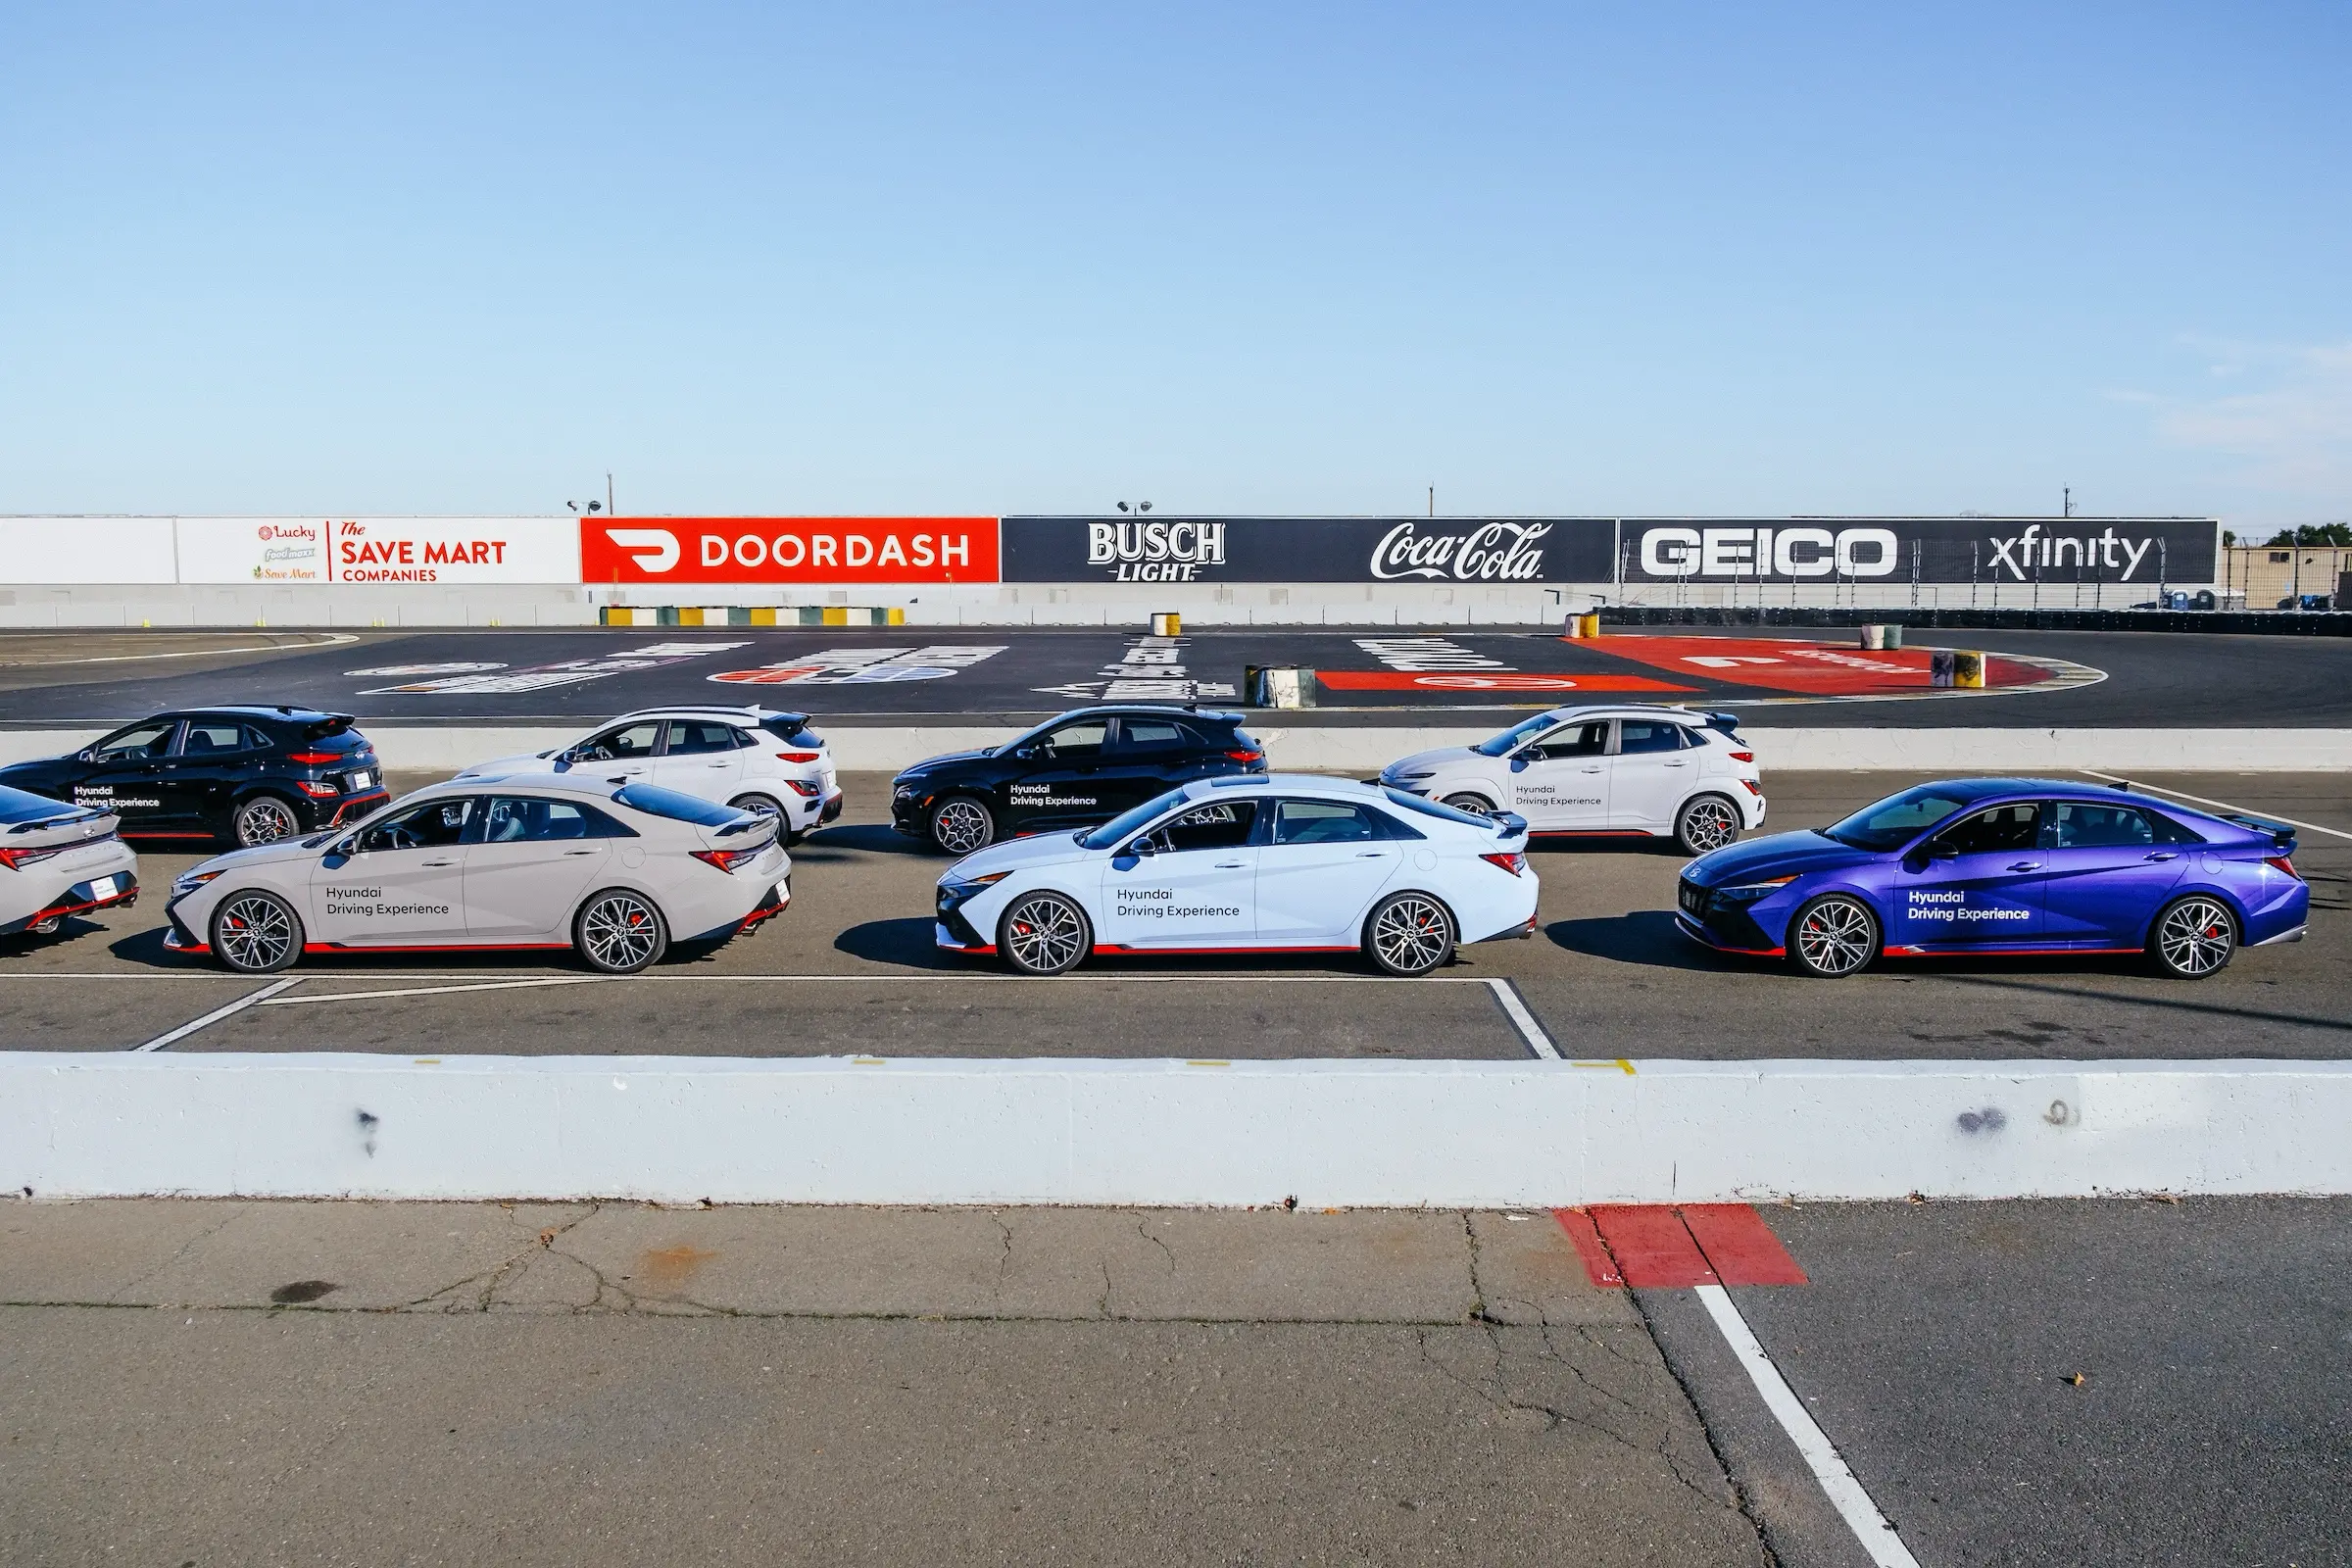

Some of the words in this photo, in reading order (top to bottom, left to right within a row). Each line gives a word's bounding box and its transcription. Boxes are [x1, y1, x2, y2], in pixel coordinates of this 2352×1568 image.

[273, 524, 316, 541] Lucky
[340, 521, 367, 536] The
[700, 532, 969, 567] DOORDASH
[1087, 522, 1226, 564] BUSCH
[1370, 521, 1554, 579] Coca-Cola
[341, 541, 415, 564] SAVE
[423, 541, 507, 564] MART
[1641, 527, 1898, 576] GEICO
[1987, 524, 2152, 581] xfinity
[265, 567, 288, 579] Save
[289, 567, 316, 579] Mart
[343, 569, 437, 582] COMPANIES
[1115, 563, 1197, 582] LIGHT
[74, 786, 113, 796] Hyundai
[1010, 785, 1050, 795] Hyundai
[1516, 785, 1555, 794] Hyundai
[74, 798, 109, 808] Driving
[109, 798, 160, 808] Experience
[1010, 796, 1044, 807] Driving
[1045, 796, 1097, 807] Experience
[1516, 797, 1548, 806] Driving
[1550, 797, 1601, 806] Experience
[326, 886, 381, 900] Hyundai
[1117, 888, 1172, 902] Hyundai
[1908, 891, 1965, 905] Hyundai
[327, 903, 373, 916] Driving
[376, 903, 449, 916] Experience
[1117, 905, 1163, 918] Driving
[1167, 905, 1240, 918] Experience
[1908, 907, 1955, 921] Driving
[1957, 907, 2030, 921] Experience
